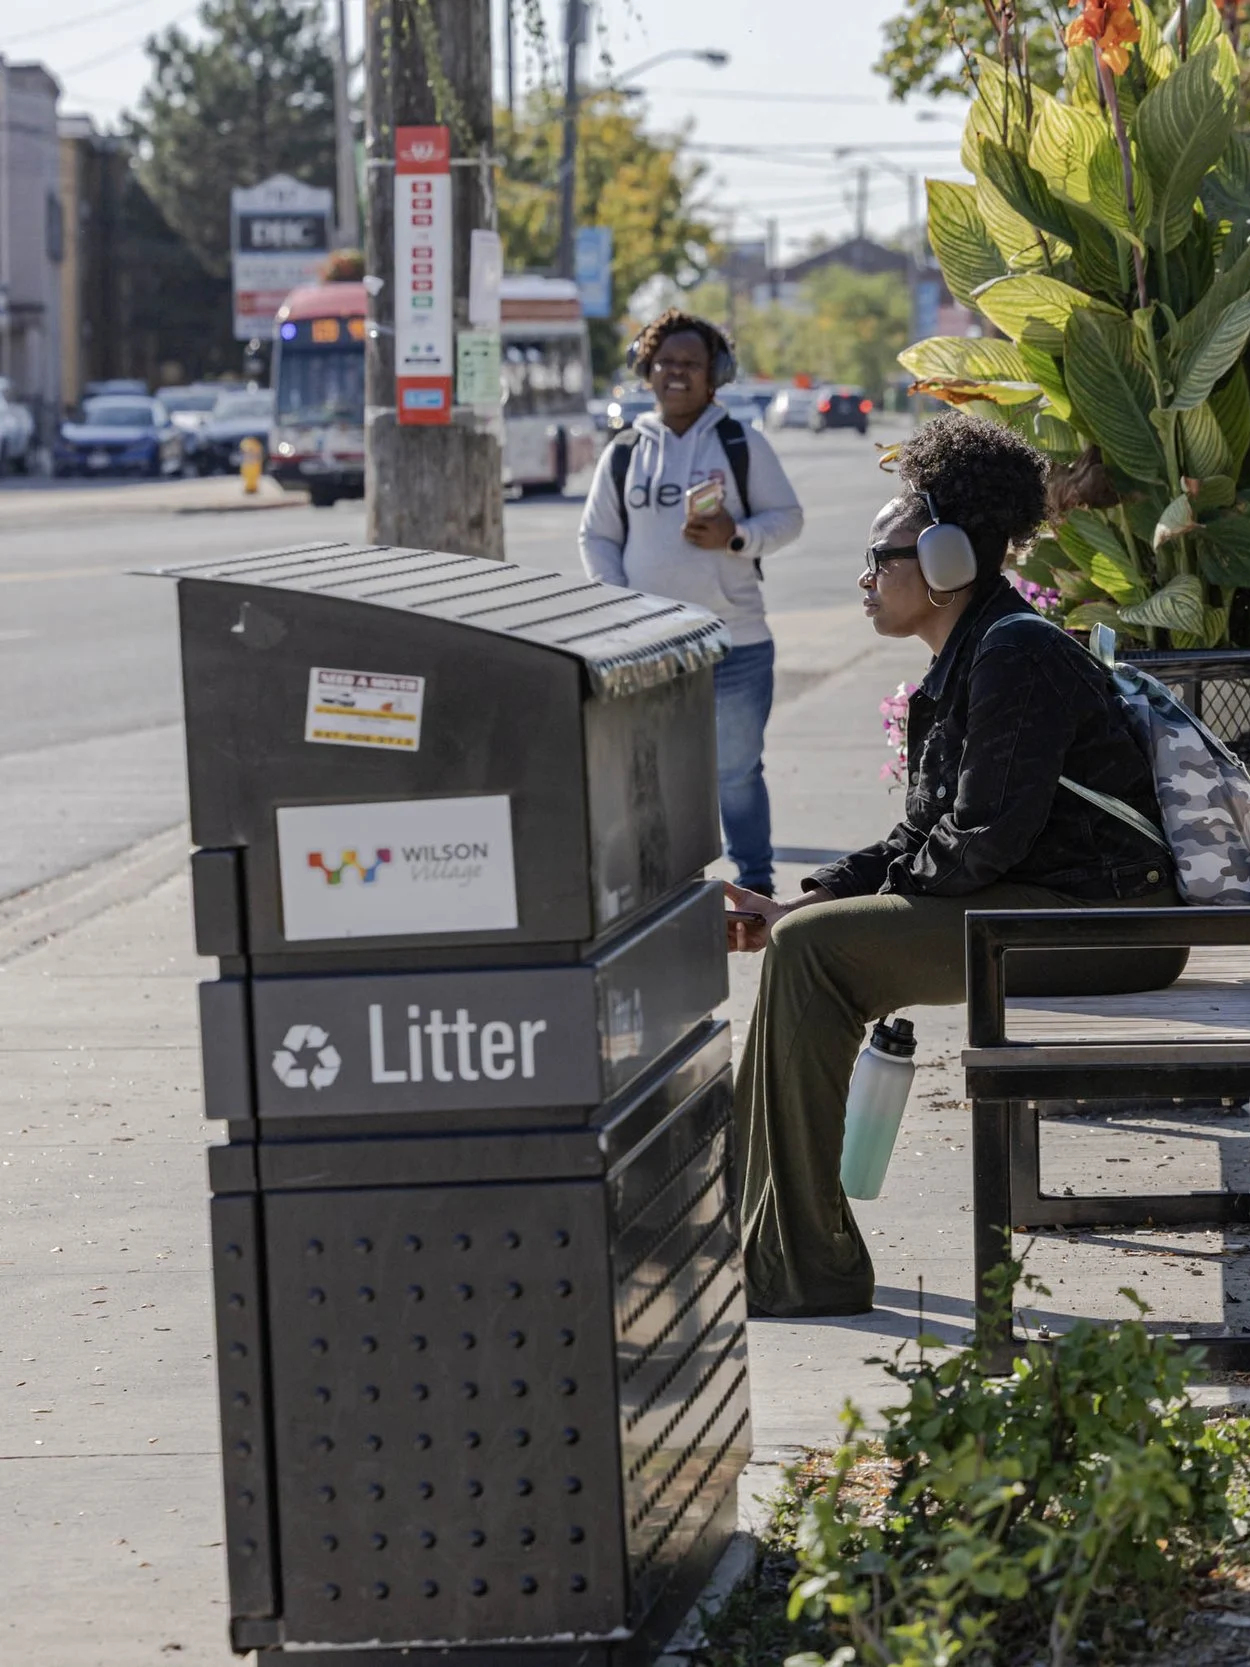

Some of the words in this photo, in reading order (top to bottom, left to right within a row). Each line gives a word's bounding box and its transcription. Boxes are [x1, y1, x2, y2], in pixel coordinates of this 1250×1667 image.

[402, 843, 489, 862] WILSON
[410, 861, 483, 887] Village
[368, 1004, 548, 1084] Litter
